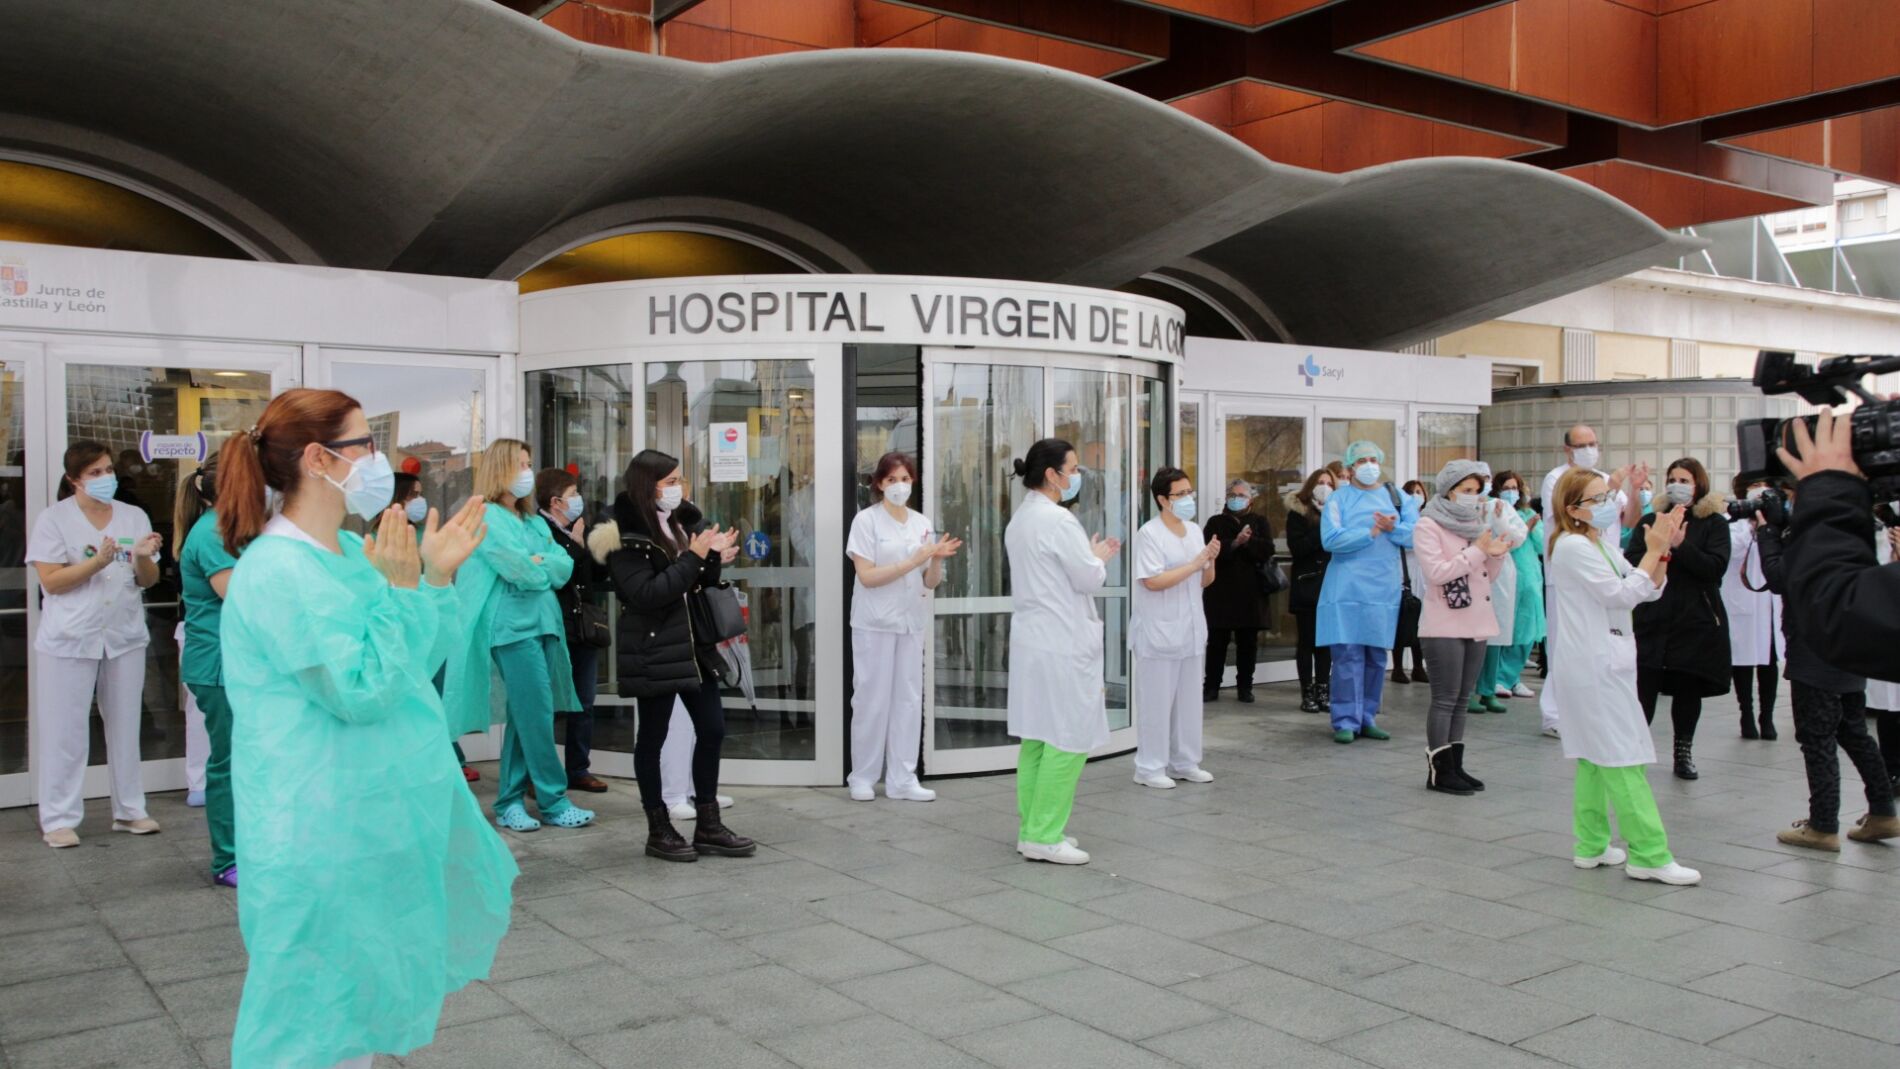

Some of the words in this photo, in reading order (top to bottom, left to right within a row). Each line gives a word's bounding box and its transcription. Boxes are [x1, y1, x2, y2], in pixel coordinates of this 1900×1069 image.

[37, 284, 81, 297] Junta
[86, 288, 105, 299] de
[53, 301, 62, 313] y
[68, 299, 106, 313] León
[649, 291, 885, 335] HOSPITAL
[910, 293, 1077, 341] VIRGEN
[1089, 305, 1129, 345] DE
[1138, 311, 1162, 351] LA
[1322, 365, 1344, 381] Sacyl
[153, 446, 196, 456] respeto
